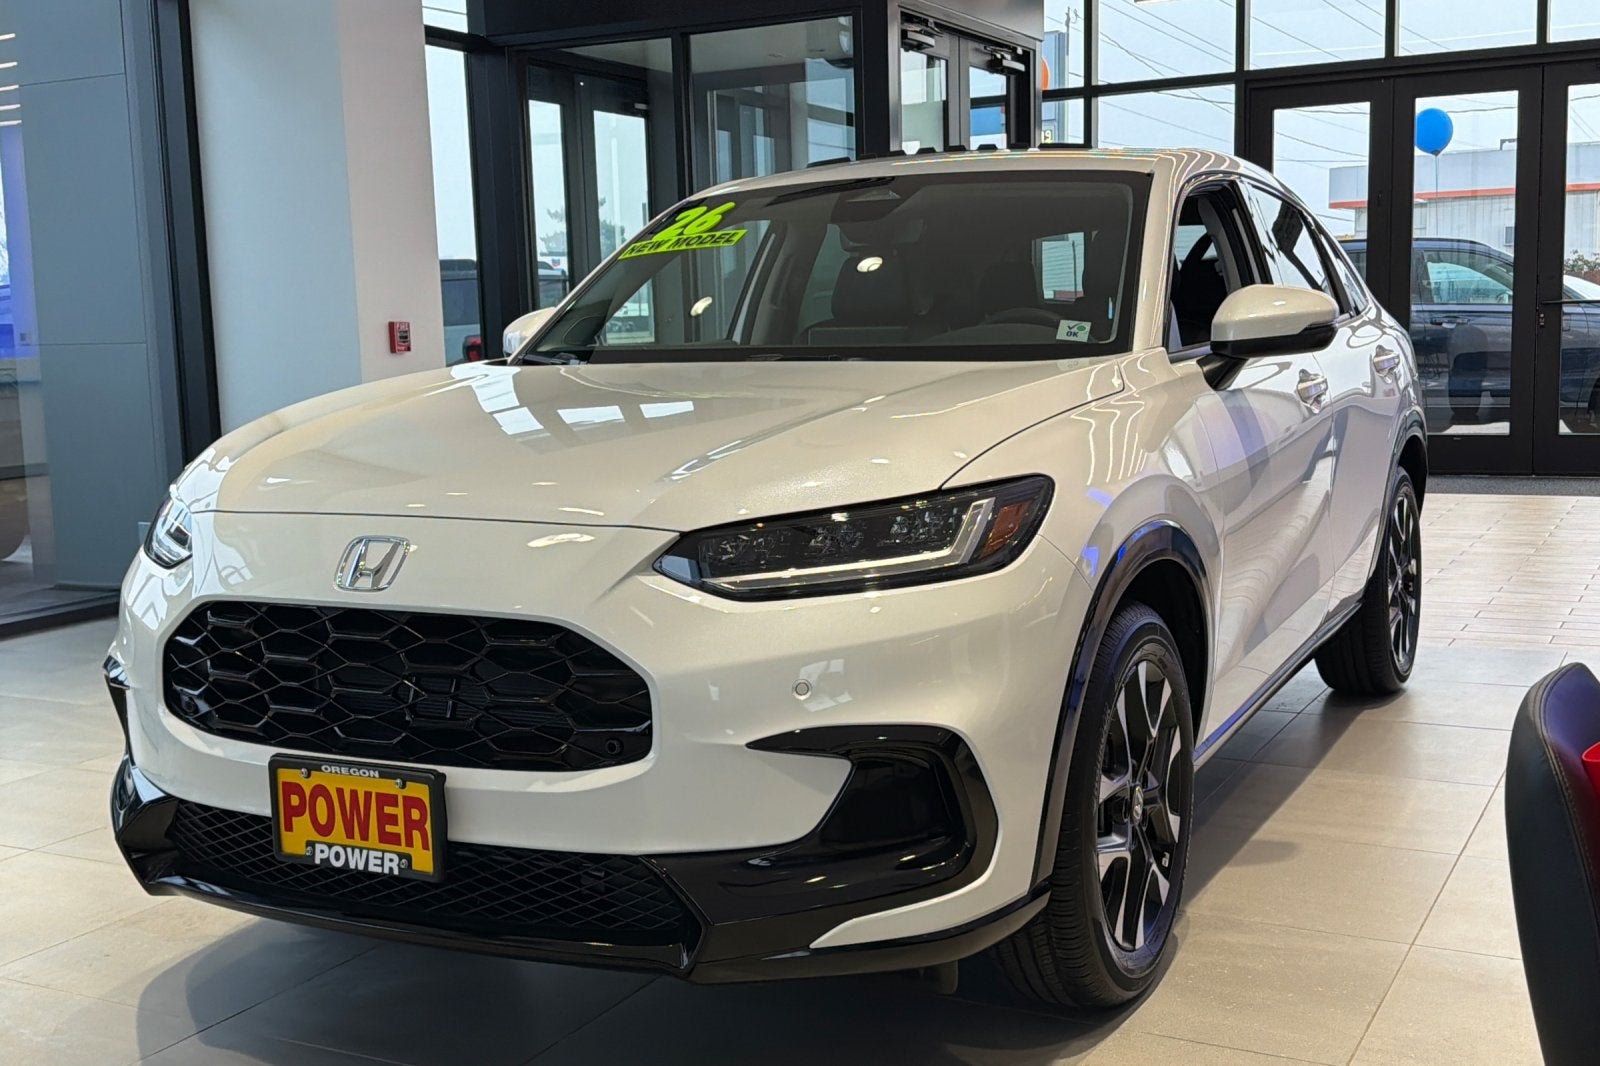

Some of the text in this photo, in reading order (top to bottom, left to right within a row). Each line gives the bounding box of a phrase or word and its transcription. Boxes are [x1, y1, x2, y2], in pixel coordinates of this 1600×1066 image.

[650, 201, 735, 242] 26
[627, 231, 737, 255] NEW MODEL
[1066, 330, 1079, 338] OK
[321, 764, 380, 779] OREGON
[281, 780, 430, 851] POWER
[314, 843, 399, 876] POWER
